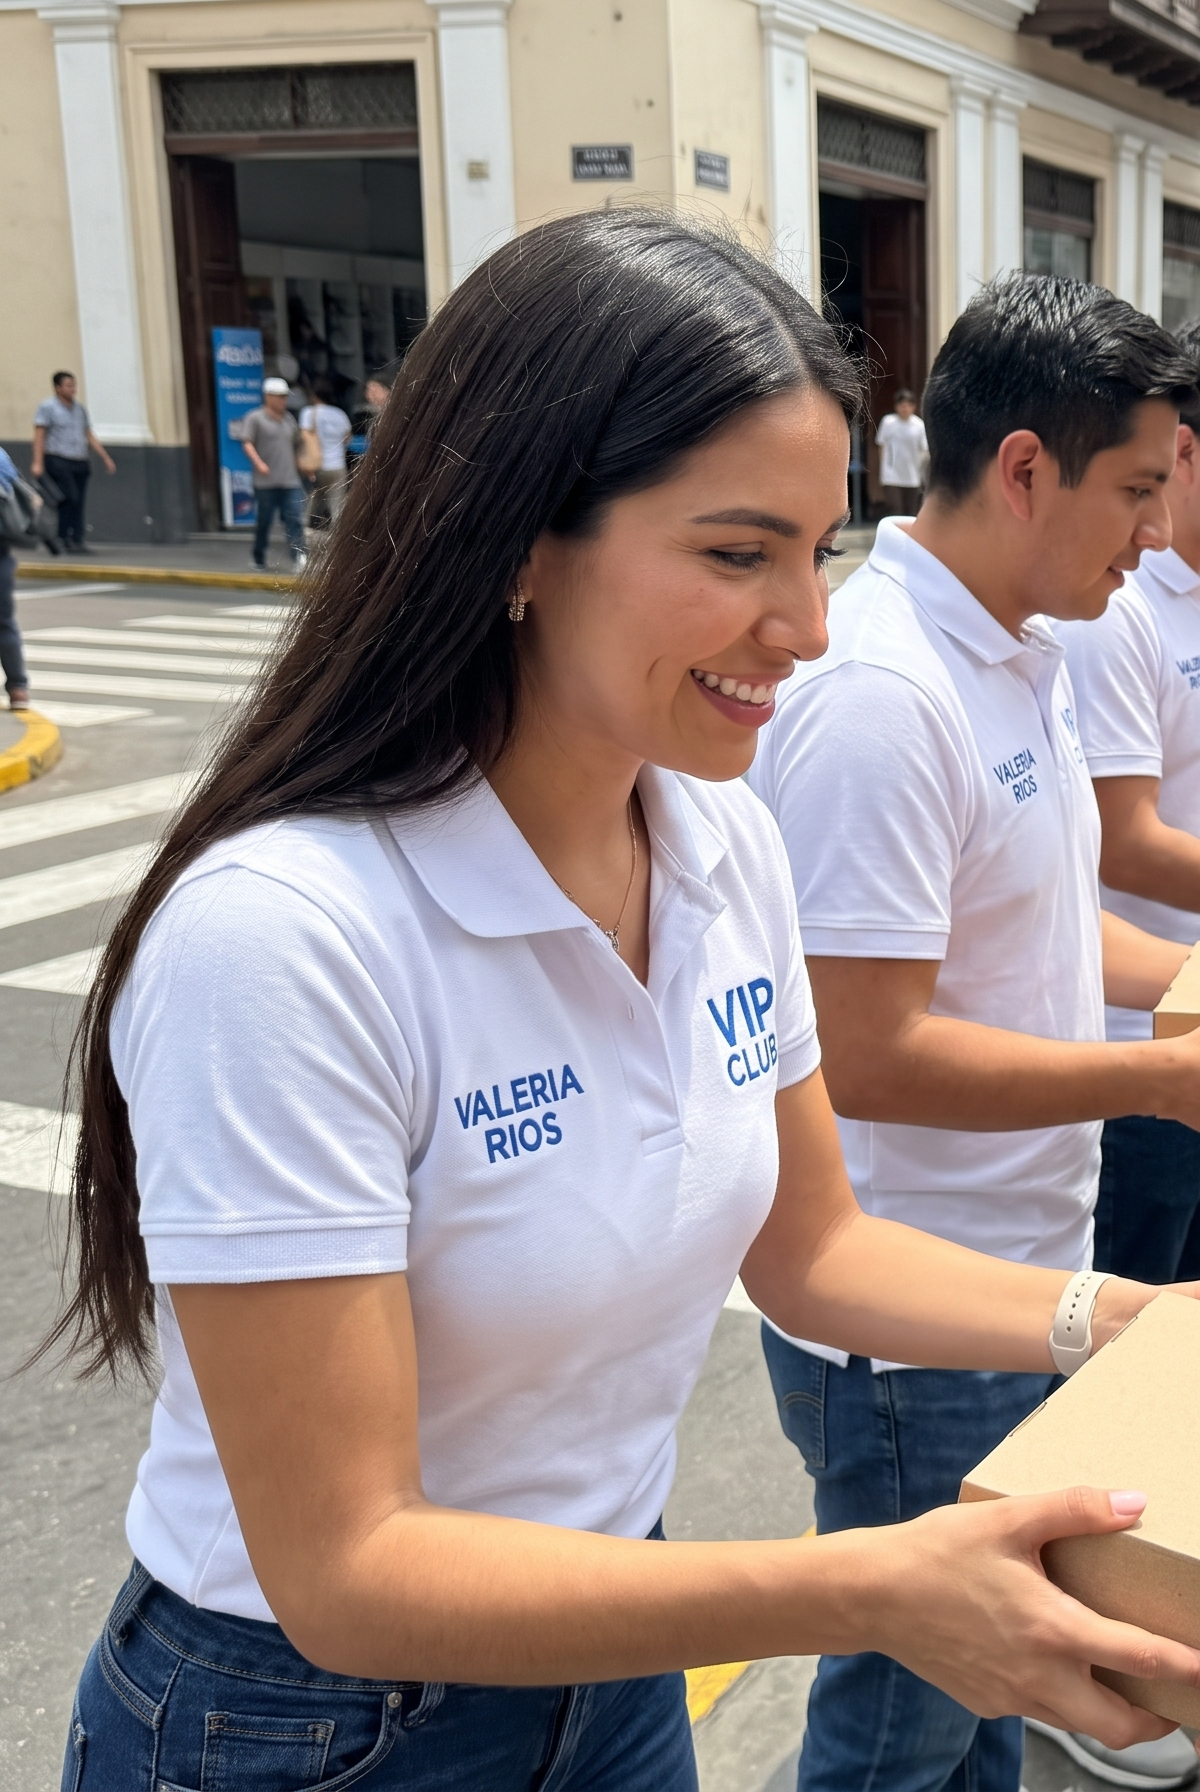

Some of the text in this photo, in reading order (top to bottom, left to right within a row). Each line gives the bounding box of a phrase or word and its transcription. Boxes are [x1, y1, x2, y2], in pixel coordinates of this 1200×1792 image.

[1012, 774, 1037, 804] RIOS
[706, 977, 774, 1048] VIP
[727, 1033, 778, 1087] CLUB
[453, 1063, 585, 1130] VALERIA
[484, 1111, 563, 1164] RIOS
